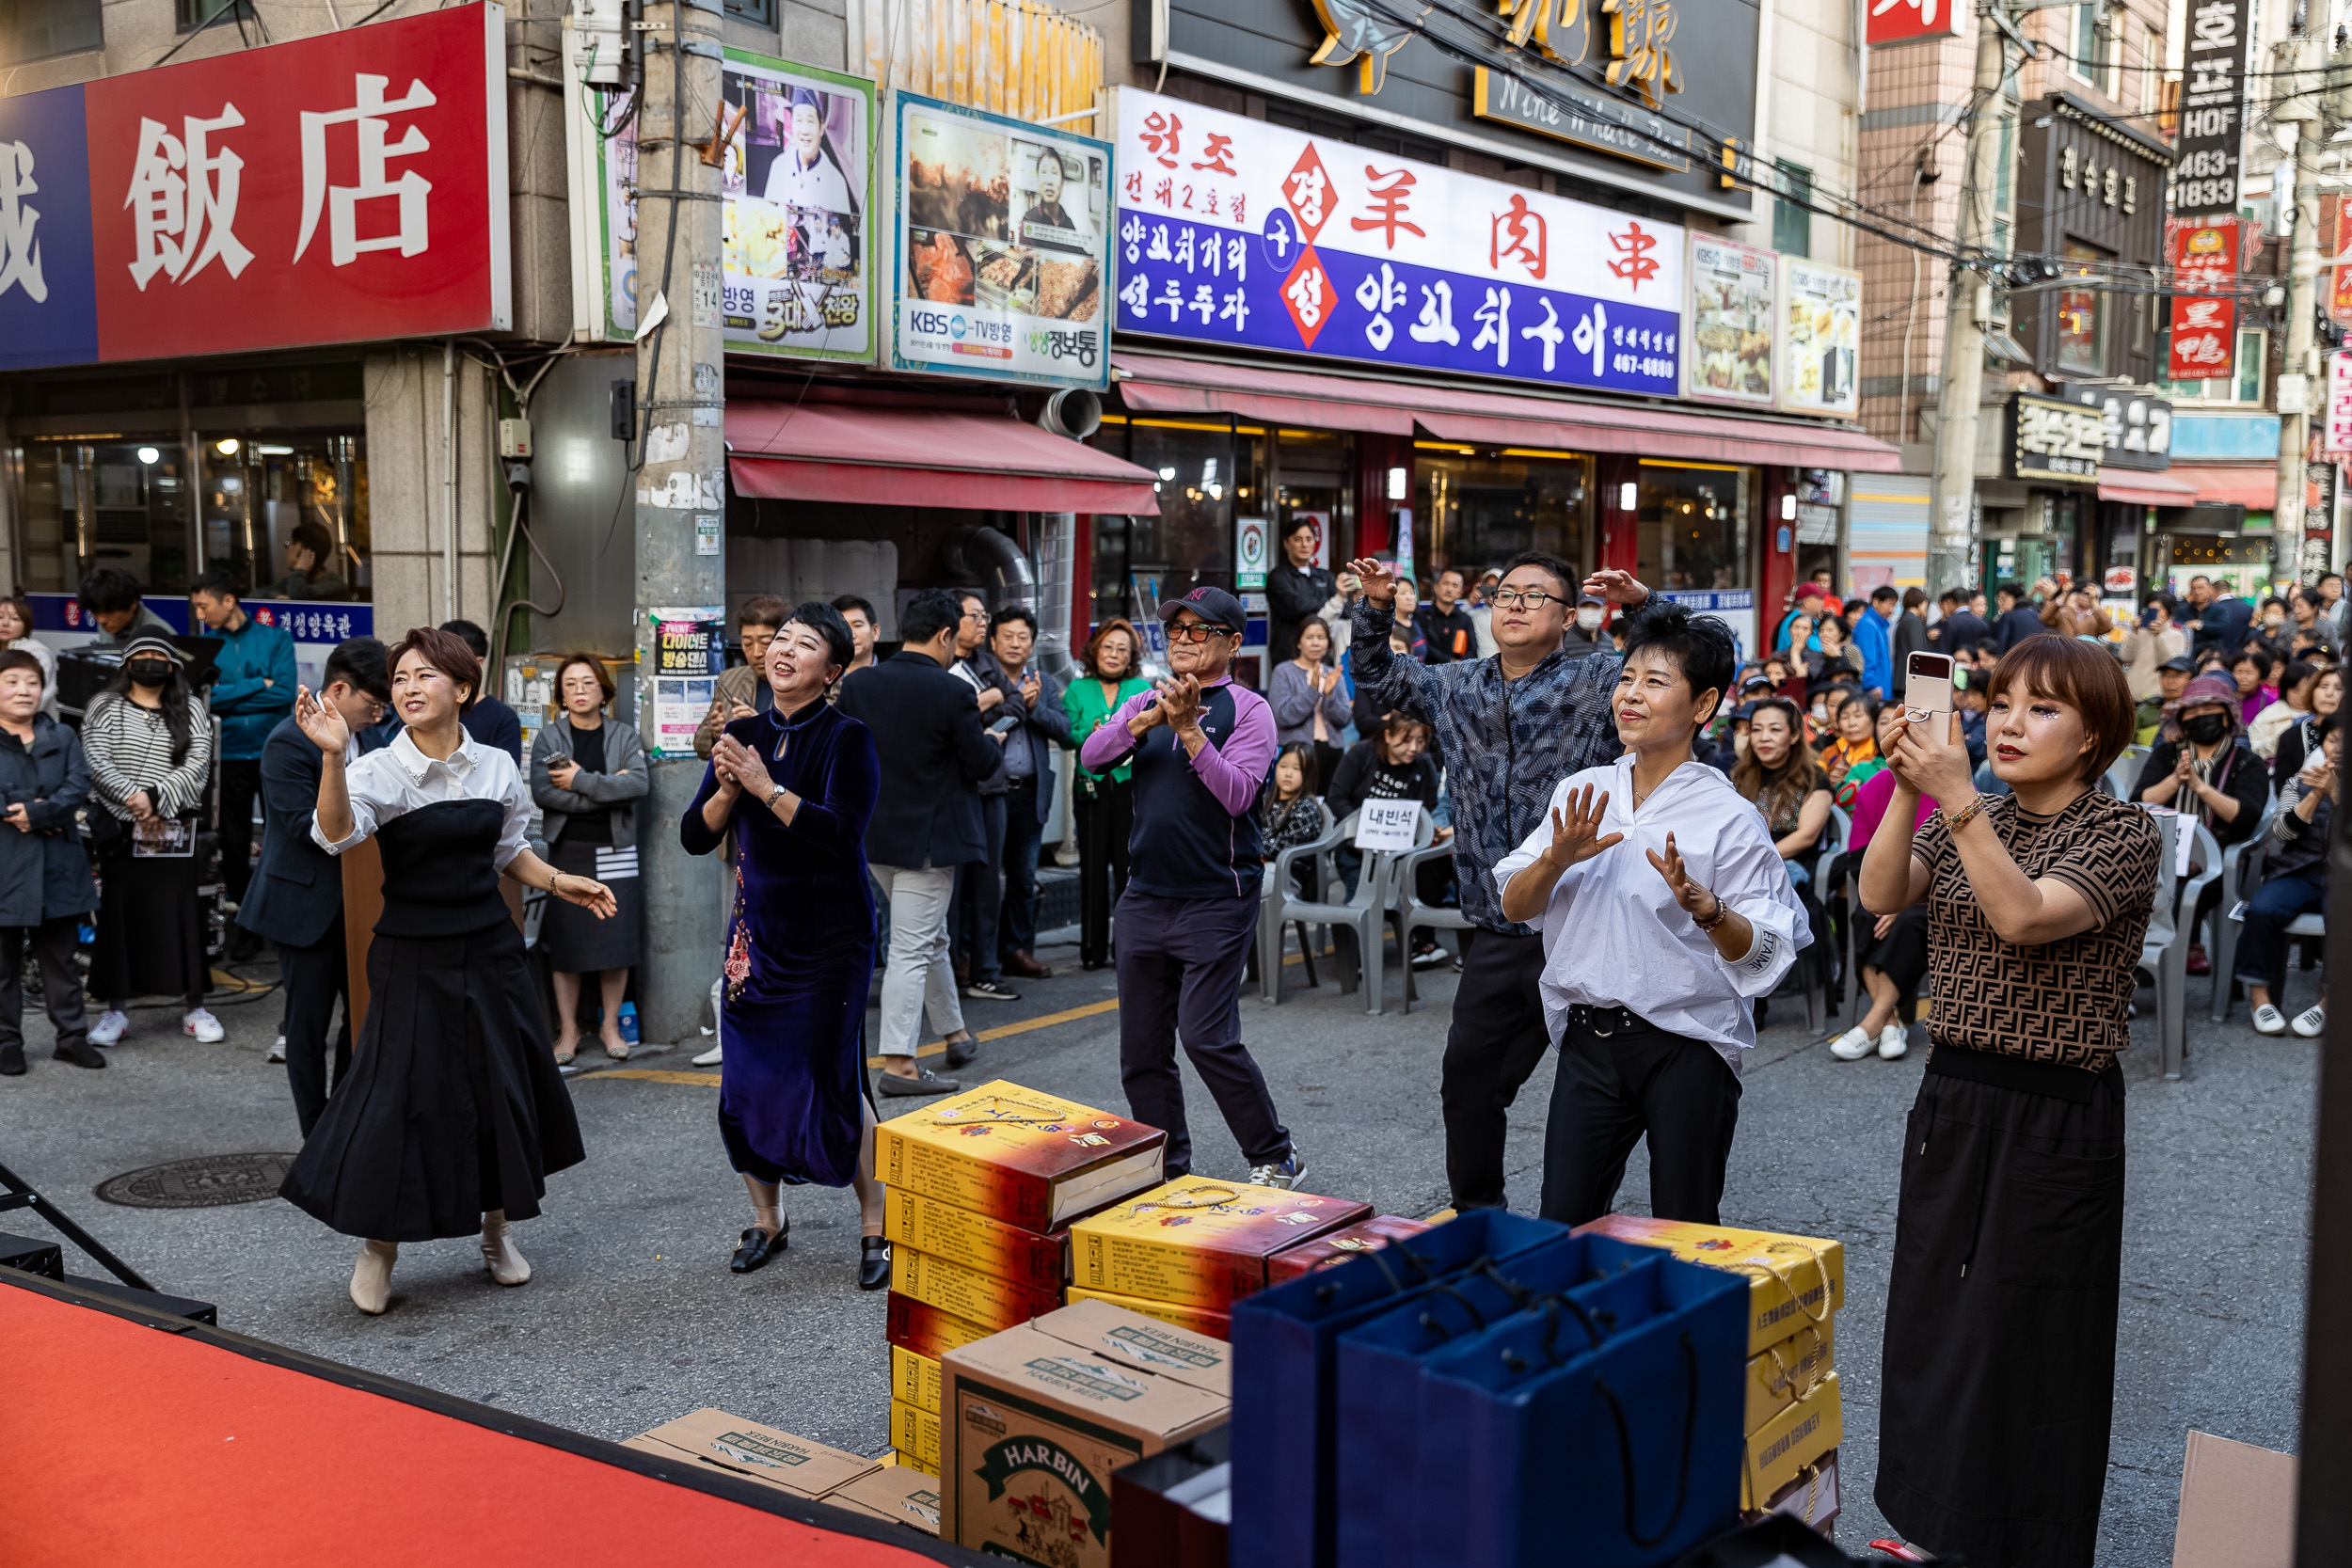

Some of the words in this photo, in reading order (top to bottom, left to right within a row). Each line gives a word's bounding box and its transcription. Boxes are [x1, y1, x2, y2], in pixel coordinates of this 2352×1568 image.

[2184, 106, 2238, 138] HOF
[1139, 111, 1237, 176] 원조
[2177, 177, 2235, 208] 1833
[1351, 165, 1660, 293] 羊肉串
[1120, 214, 1247, 282] 양꼬치거리
[1119, 272, 1250, 332] 선두주자
[911, 310, 948, 336] KBS
[1355, 262, 1608, 377] 양꼬치구이
[1369, 809, 1412, 827] 내빈석
[1025, 1369, 1074, 1391] HARBIN
[1074, 1385, 1110, 1402] BEER
[745, 1430, 771, 1444] BEER
[771, 1437, 811, 1455] HARBIN
[1003, 1444, 1090, 1495] HARBIN
